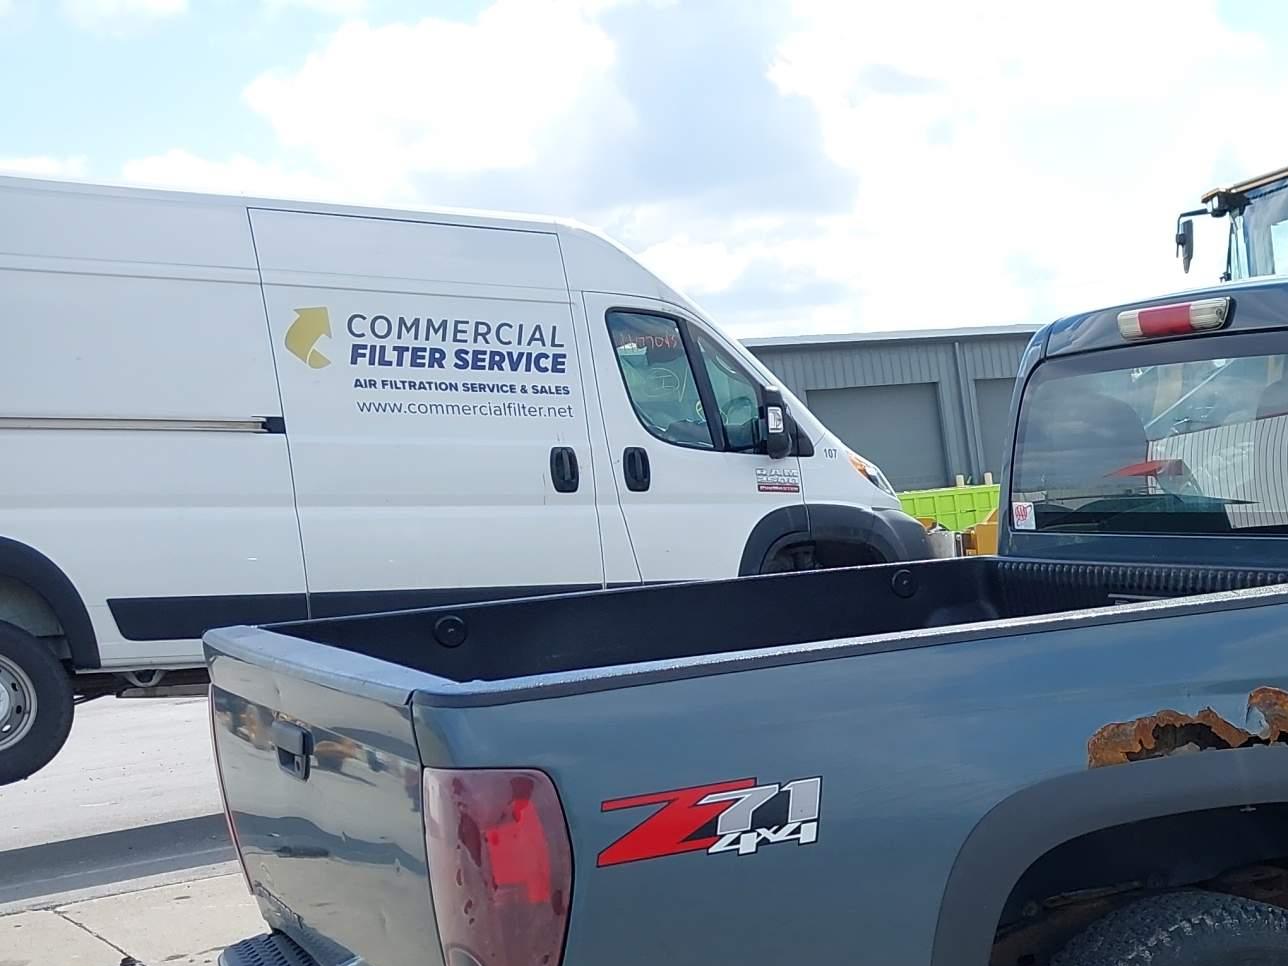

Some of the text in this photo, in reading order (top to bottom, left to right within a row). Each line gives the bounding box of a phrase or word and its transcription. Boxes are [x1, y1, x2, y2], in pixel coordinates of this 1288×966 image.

[347, 313, 564, 347] COMMERCIAL
[350, 343, 567, 374] FILTER SERVICE
[354, 378, 571, 395] AIR FILTRATION SERVICE & SALES
[356, 400, 575, 418] www.commercialfilter.net
[823, 448, 838, 459] 107
[756, 467, 799, 477] RAM
[597, 776, 822, 867] Z71
